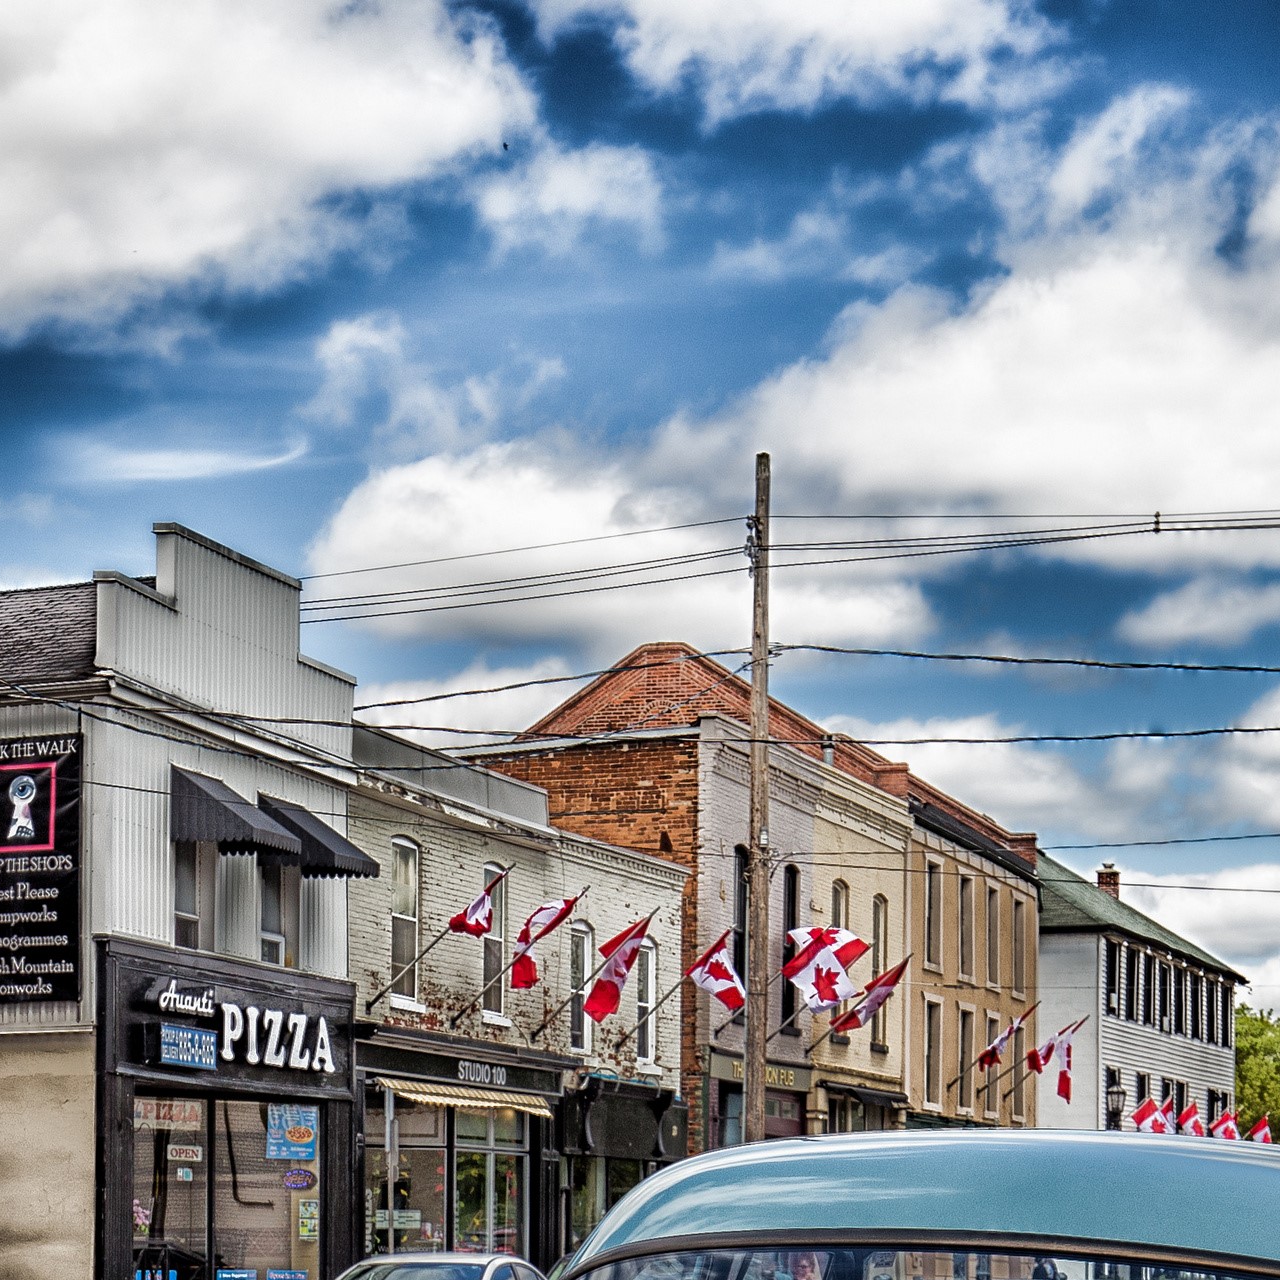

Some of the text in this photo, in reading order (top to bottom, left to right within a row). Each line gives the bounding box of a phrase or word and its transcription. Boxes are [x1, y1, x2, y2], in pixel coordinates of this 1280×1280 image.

[11, 742, 35, 758] THE
[36, 739, 77, 755] WALK
[6, 857, 30, 873] THE
[30, 855, 73, 872] SHOPS
[16, 882, 59, 900] Please
[11, 956, 74, 975] Mountain
[221, 1003, 335, 1073] PIZZA
[458, 1060, 506, 1085] STUDIO 100
[732, 1061, 744, 1078] TH
[780, 1069, 794, 1086] PUB
[143, 1102, 198, 1121] PIZZA
[170, 1148, 199, 1158] OPEN
